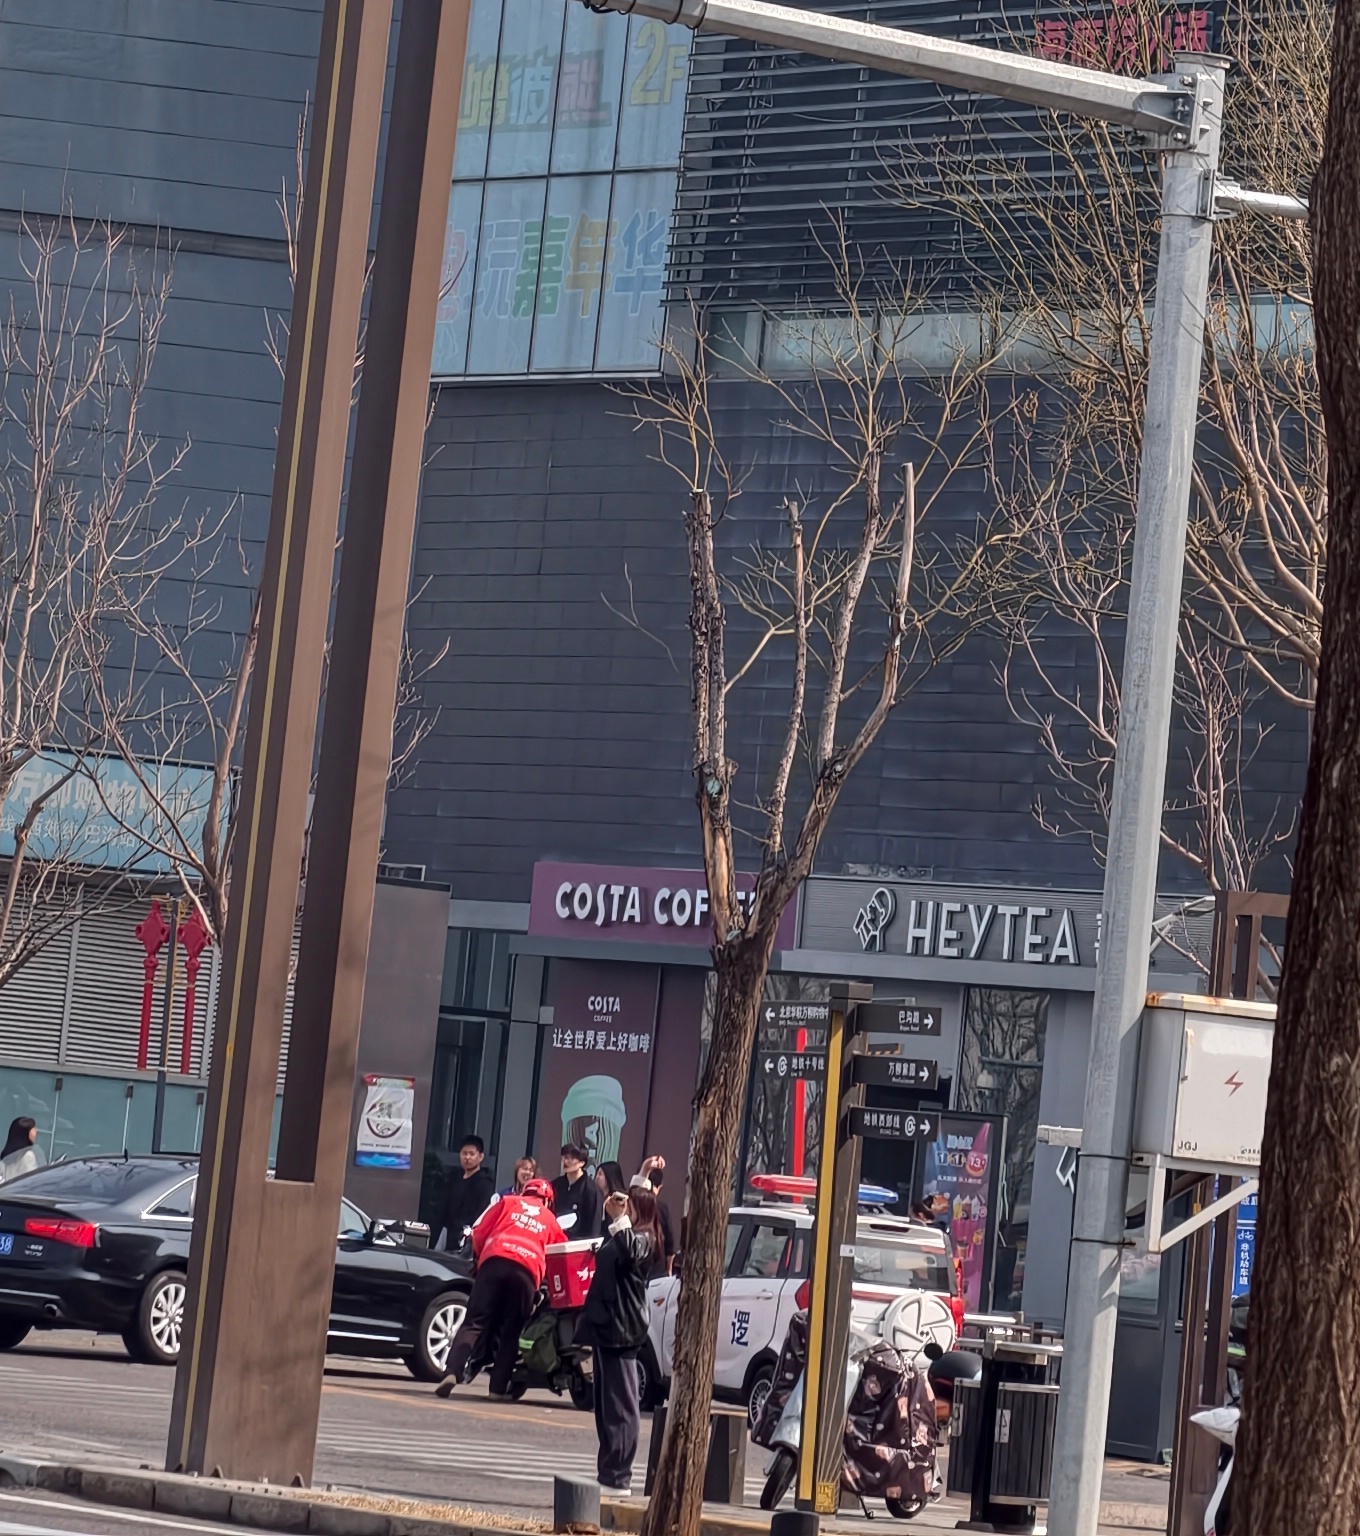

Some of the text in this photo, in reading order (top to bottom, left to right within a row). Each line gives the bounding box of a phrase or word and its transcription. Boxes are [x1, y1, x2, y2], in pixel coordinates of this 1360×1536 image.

[630, 21, 688, 107] 2F
[555, 881, 756, 928] COSTA COF
[906, 899, 1076, 965] HEYTEA
[588, 995, 621, 1014] COSTA
[552, 1028, 652, 1054] 让全世界爱上好咖啡
[1177, 1140, 1198, 1152] JGJ
[731, 1309, 751, 1347] 逻
